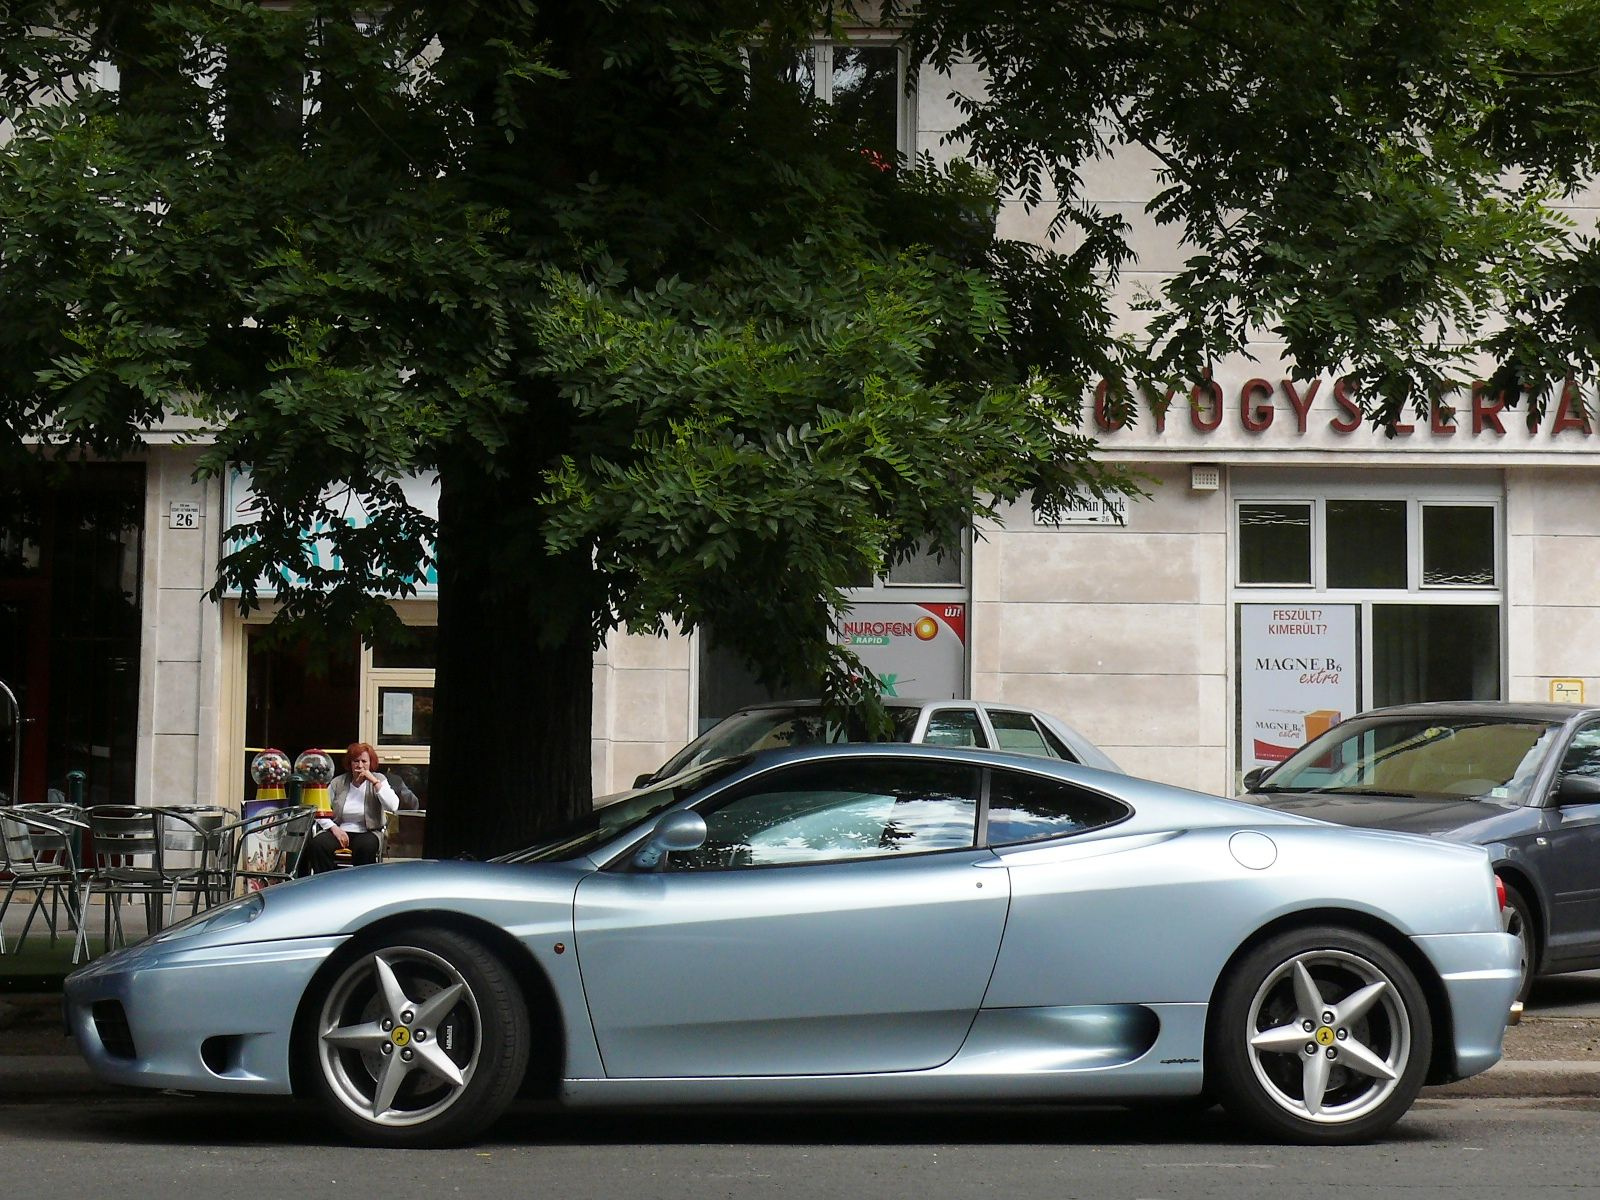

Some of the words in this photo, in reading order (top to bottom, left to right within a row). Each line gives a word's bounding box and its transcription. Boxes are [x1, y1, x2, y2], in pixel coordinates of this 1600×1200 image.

[176, 513, 193, 527] 26
[1273, 608, 1322, 621] FESZÜLT?
[844, 621, 913, 637] NUROFEN
[1268, 622, 1328, 635] KIMERÜLT?
[1255, 657, 1321, 671] MAGNE
[1299, 667, 1339, 685] extra
[1255, 721, 1289, 731] MAGNE
